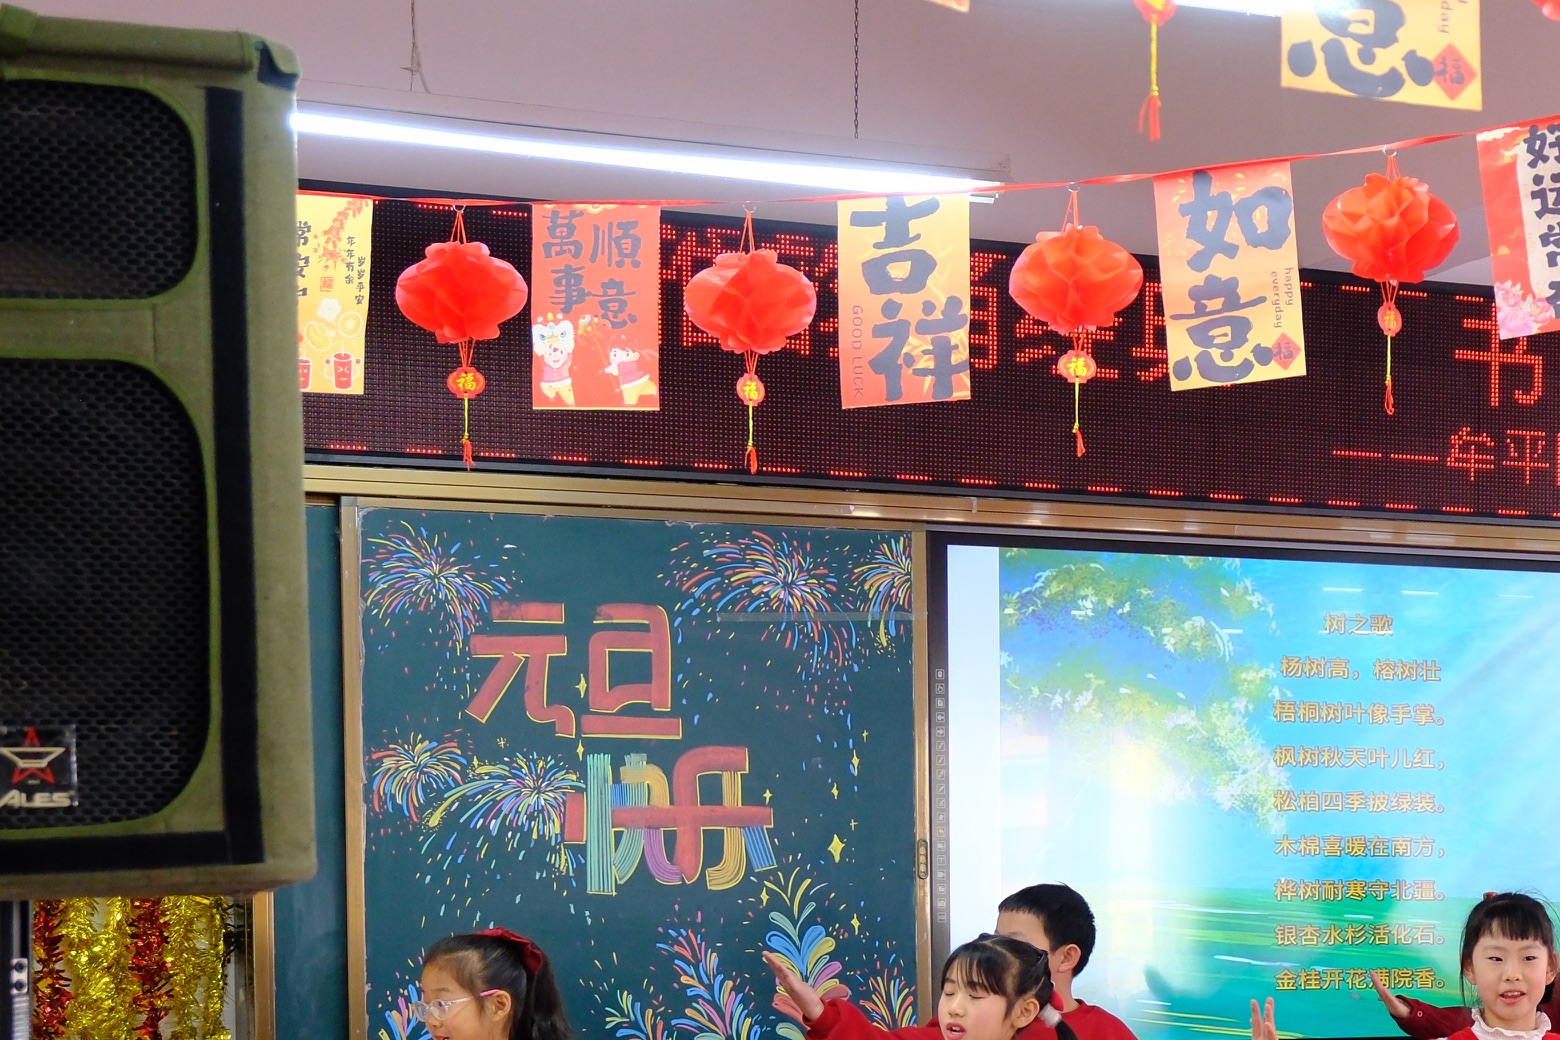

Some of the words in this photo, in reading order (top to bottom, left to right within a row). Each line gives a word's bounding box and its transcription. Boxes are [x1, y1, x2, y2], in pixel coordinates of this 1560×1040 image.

[344, 235, 356, 285] 年年有余
[1170, 169, 1294, 383] 如意
[354, 255, 367, 306] 岁岁平安
[1284, 267, 1294, 306] happy
[849, 195, 970, 402] 吉祥
[1271, 271, 1284, 329] everyday
[852, 305, 864, 351] GOOD
[456, 372, 477, 391] 福
[853, 356, 865, 398] LUCK
[1067, 356, 1088, 377] 福
[743, 380, 759, 400] 福
[1323, 612, 1394, 636] 树之歌
[465, 602, 682, 739] 元旦
[1273, 700, 1445, 726] 梧桐树叶像手掌。
[1273, 745, 1446, 770] 枫树秋天叶儿红，
[1273, 790, 1445, 813] 松柏四季披绿装。
[564, 745, 777, 896] 快乐
[1274, 835, 1446, 858] 木棉喜暖在南方，
[1274, 879, 1446, 901] 桦树耐寒守北疆。
[1274, 923, 1446, 946] 银杏水杉活化石。
